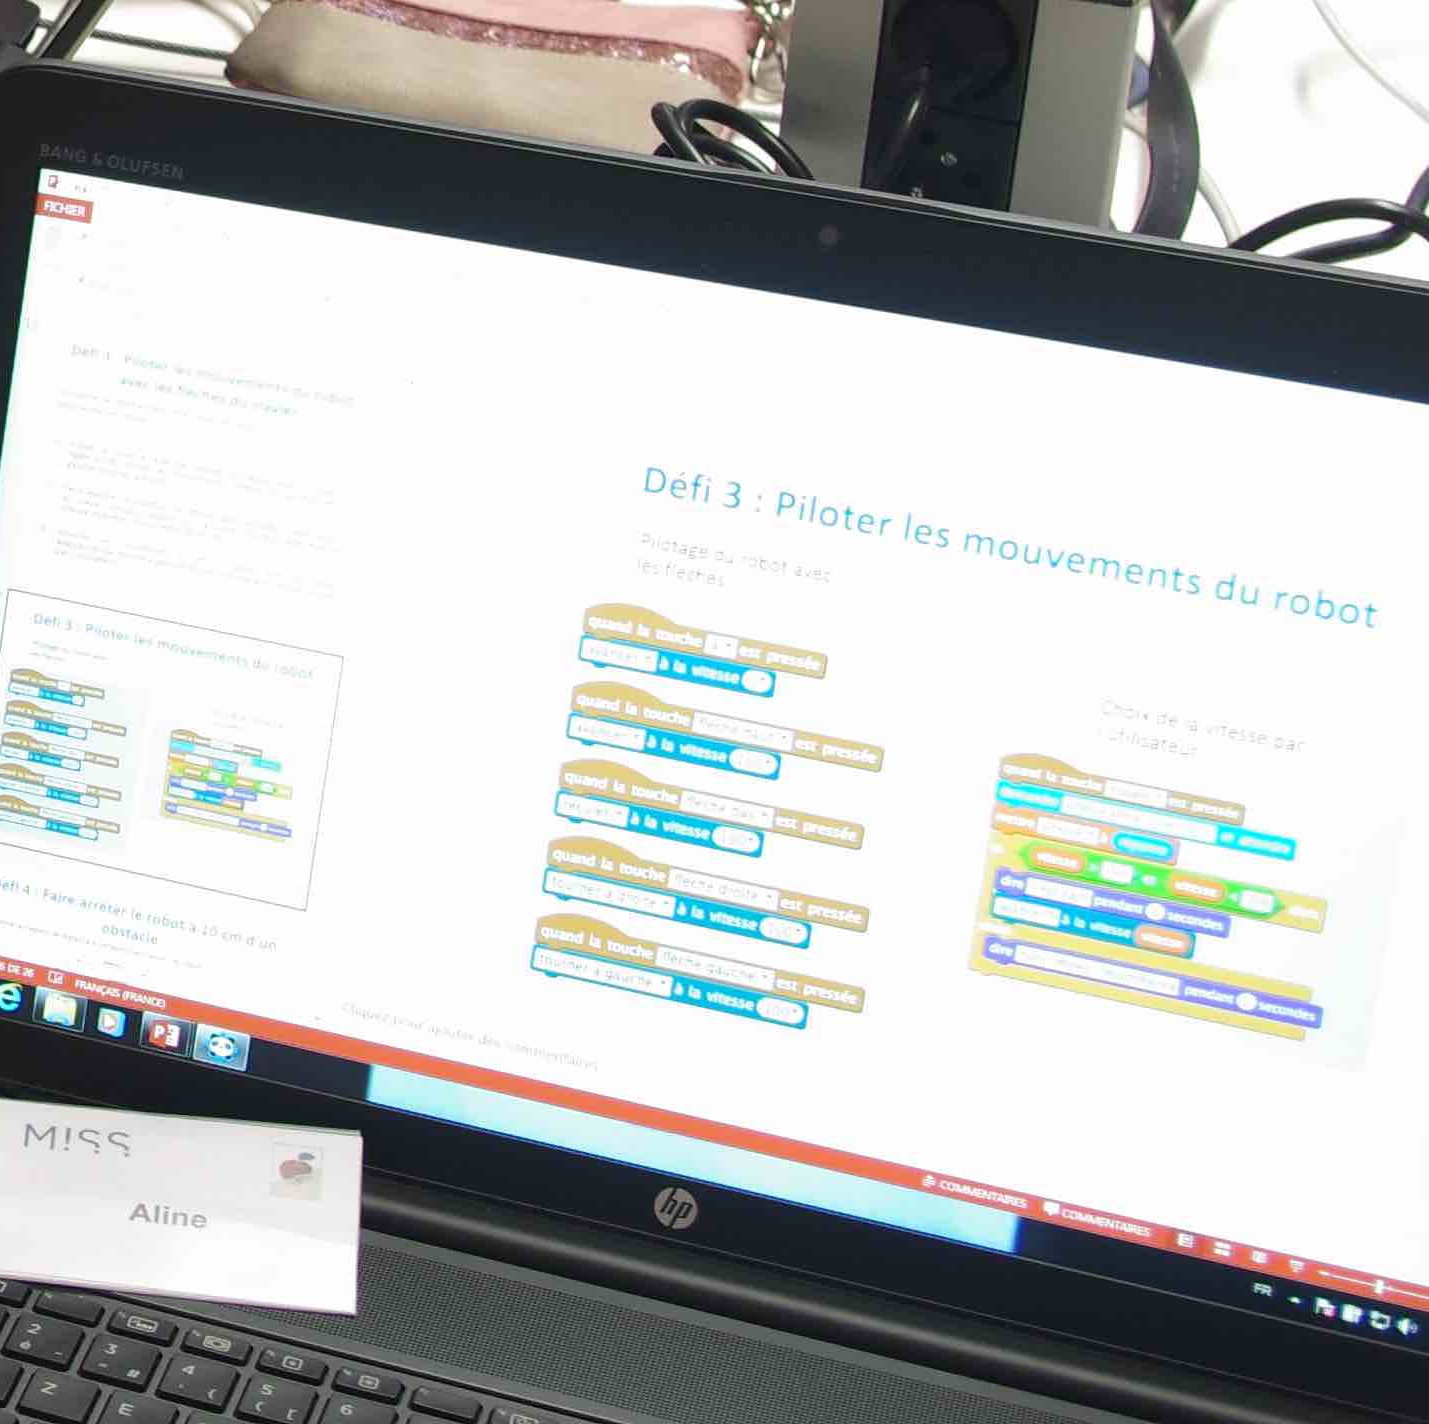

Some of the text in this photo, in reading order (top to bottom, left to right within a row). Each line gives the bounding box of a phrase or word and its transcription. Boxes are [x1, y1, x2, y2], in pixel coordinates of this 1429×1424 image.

[38, 141, 184, 181] BANG & OLUFSEN
[642, 464, 713, 505] Défi
[721, 478, 744, 511] 3
[774, 488, 894, 538] Piloter
[902, 511, 952, 549] les
[961, 524, 1203, 597] mouvements
[1213, 569, 1262, 607] du
[1273, 580, 1381, 629] robot
[658, 1188, 696, 1229] hp
[938, 1178, 1028, 1211] COMMENTAIRES
[128, 1202, 209, 1229] Aline
[1060, 1206, 1152, 1239] COMMENTAIRES
[1251, 1281, 1273, 1298] FR
